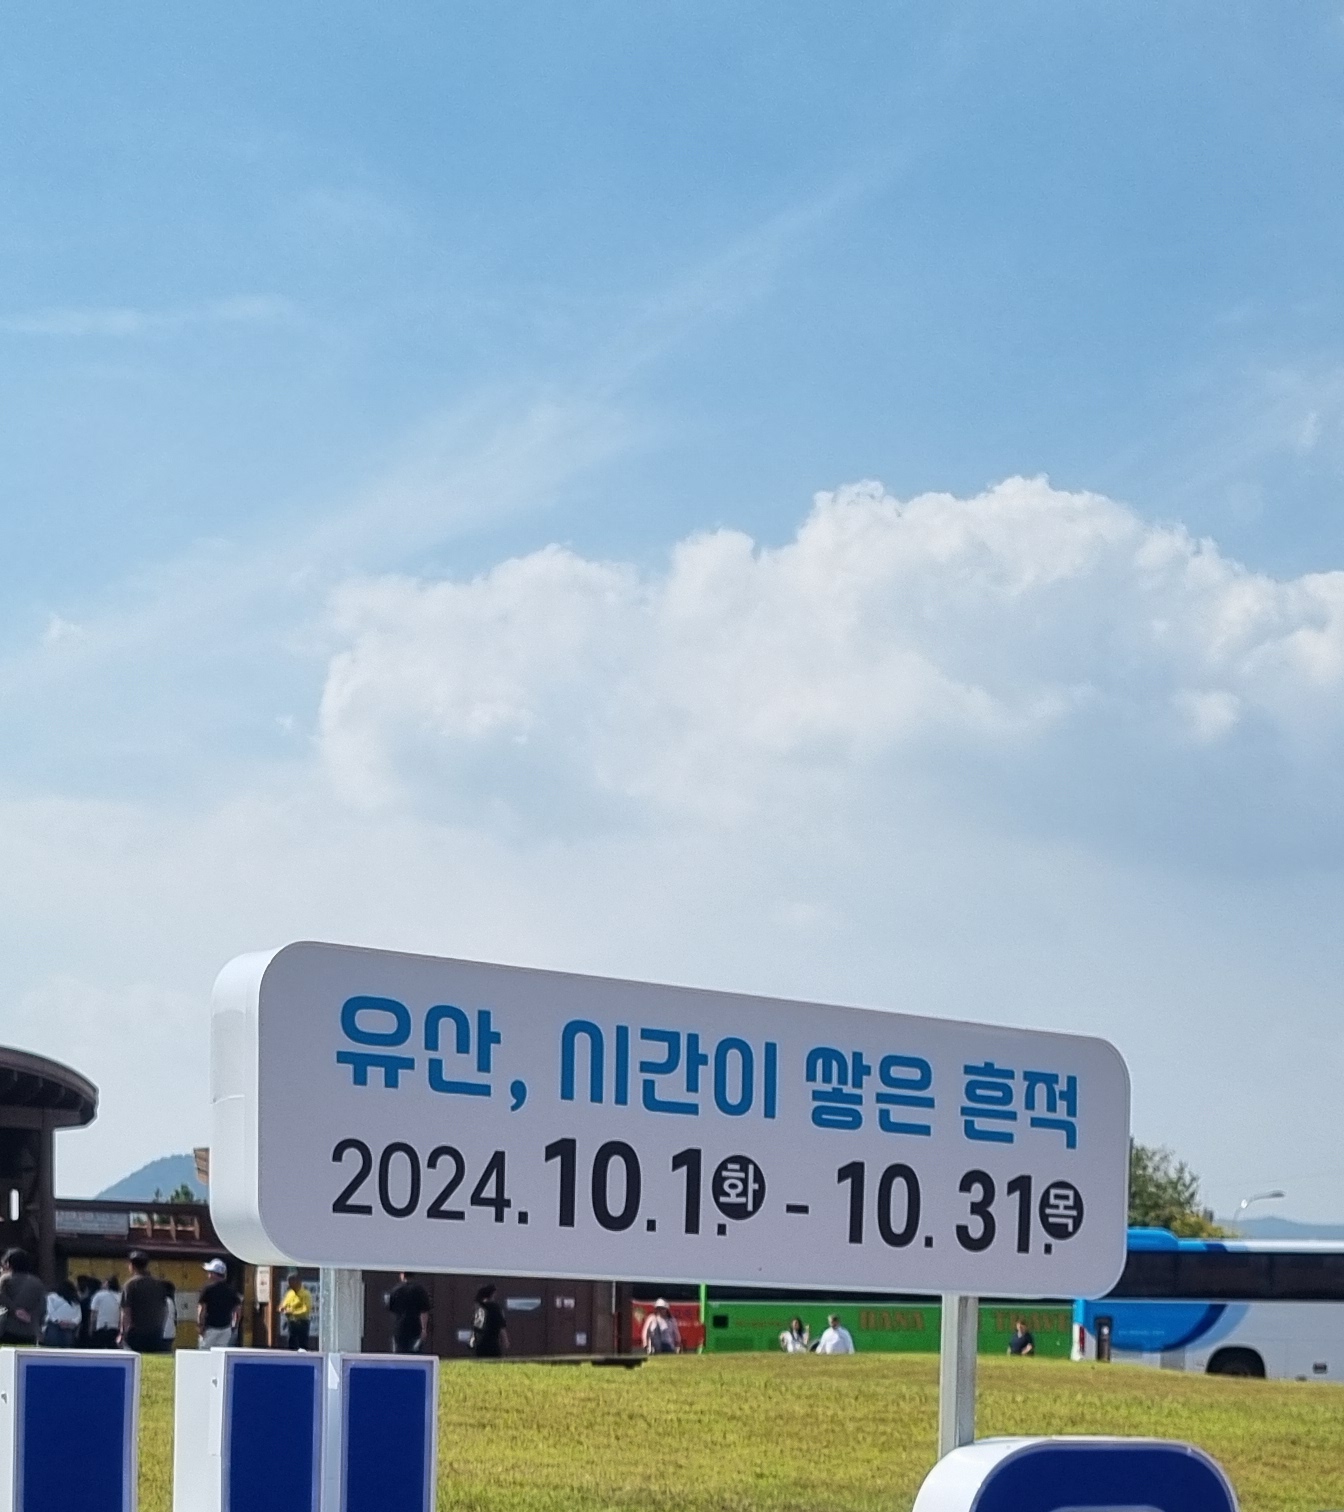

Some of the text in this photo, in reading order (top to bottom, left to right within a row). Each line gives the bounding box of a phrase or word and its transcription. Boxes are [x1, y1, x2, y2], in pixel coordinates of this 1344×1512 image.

[336, 995, 1078, 1149] 유산, 시간이 쌓은 흔적
